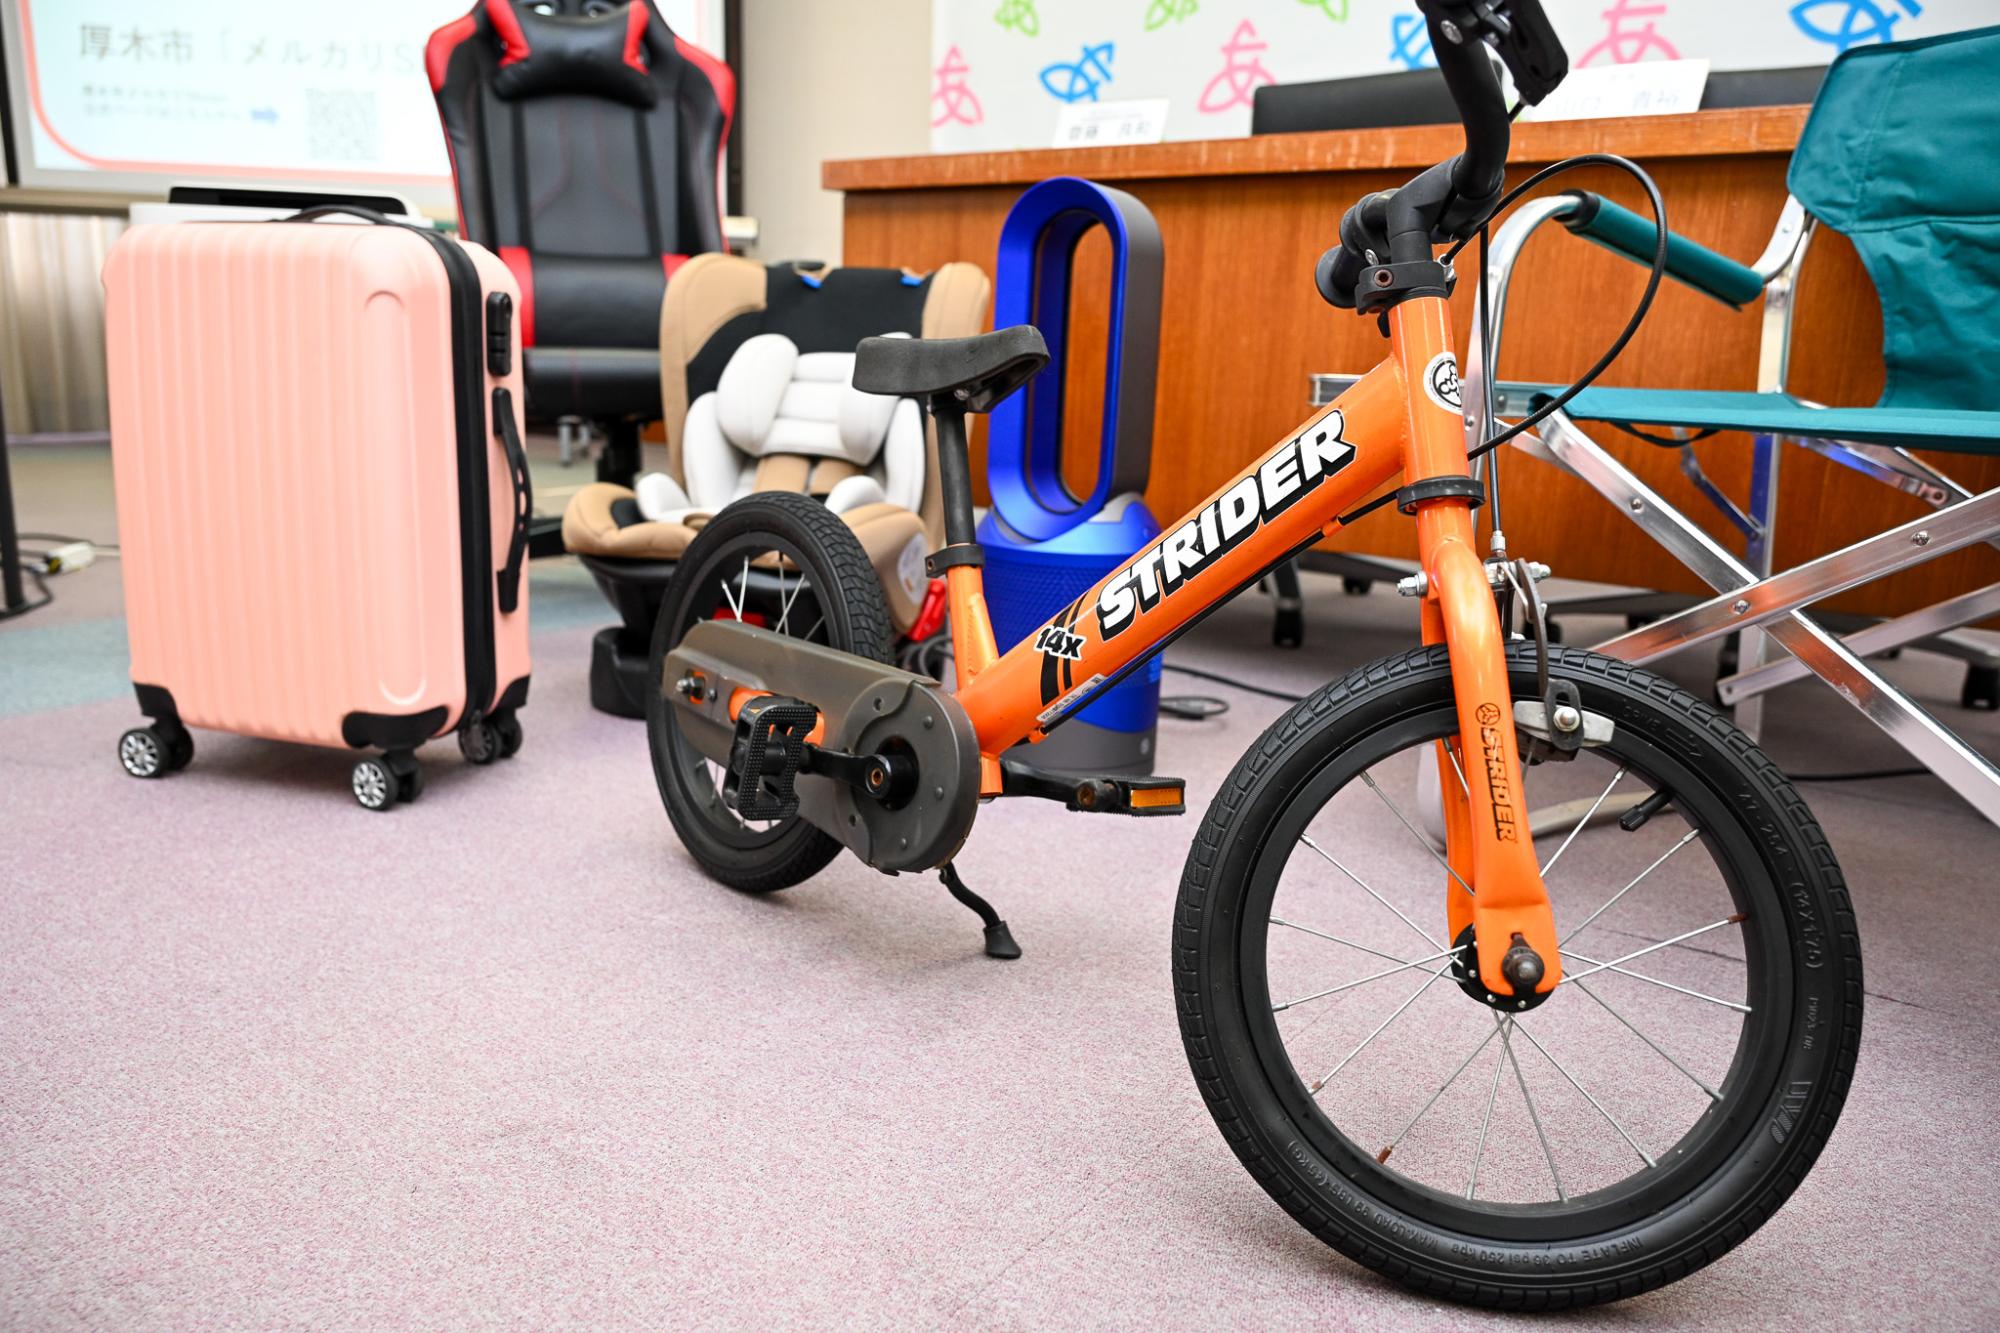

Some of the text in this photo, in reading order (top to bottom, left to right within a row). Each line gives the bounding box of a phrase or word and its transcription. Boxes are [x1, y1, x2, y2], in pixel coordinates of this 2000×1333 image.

[1097, 410, 1357, 642] STRIDER
[1481, 727, 1517, 843] STRIDER
[1478, 1250, 1504, 1264] 250
[1555, 1251, 1577, 1266] TO
[1581, 1235, 1643, 1264] INFLATE
